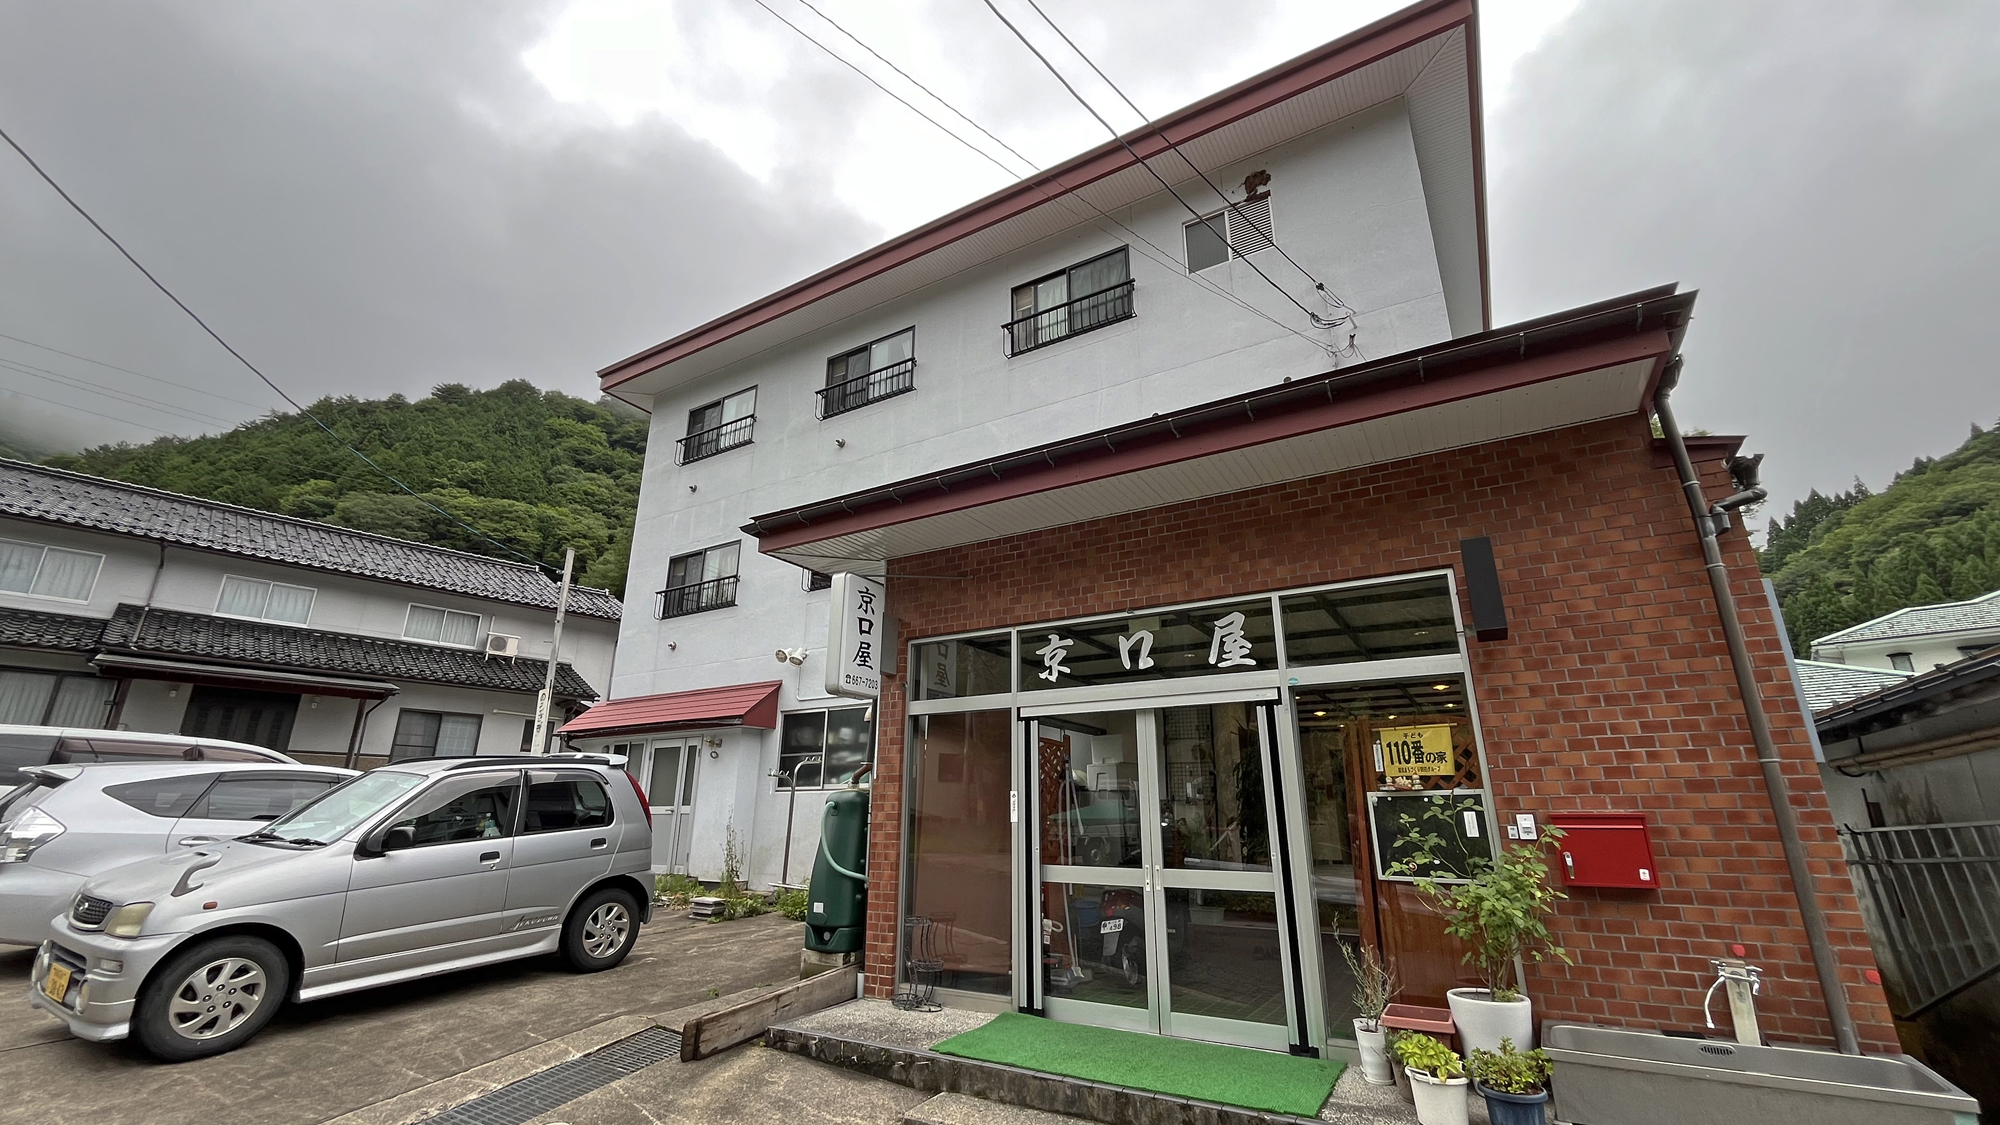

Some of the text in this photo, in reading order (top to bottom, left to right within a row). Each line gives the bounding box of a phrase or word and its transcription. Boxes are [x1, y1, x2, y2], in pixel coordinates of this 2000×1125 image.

[852, 586, 877, 671] 京口屋
[1036, 611, 1257, 683] 京口屋
[1386, 740, 1448, 765] 110番の家
